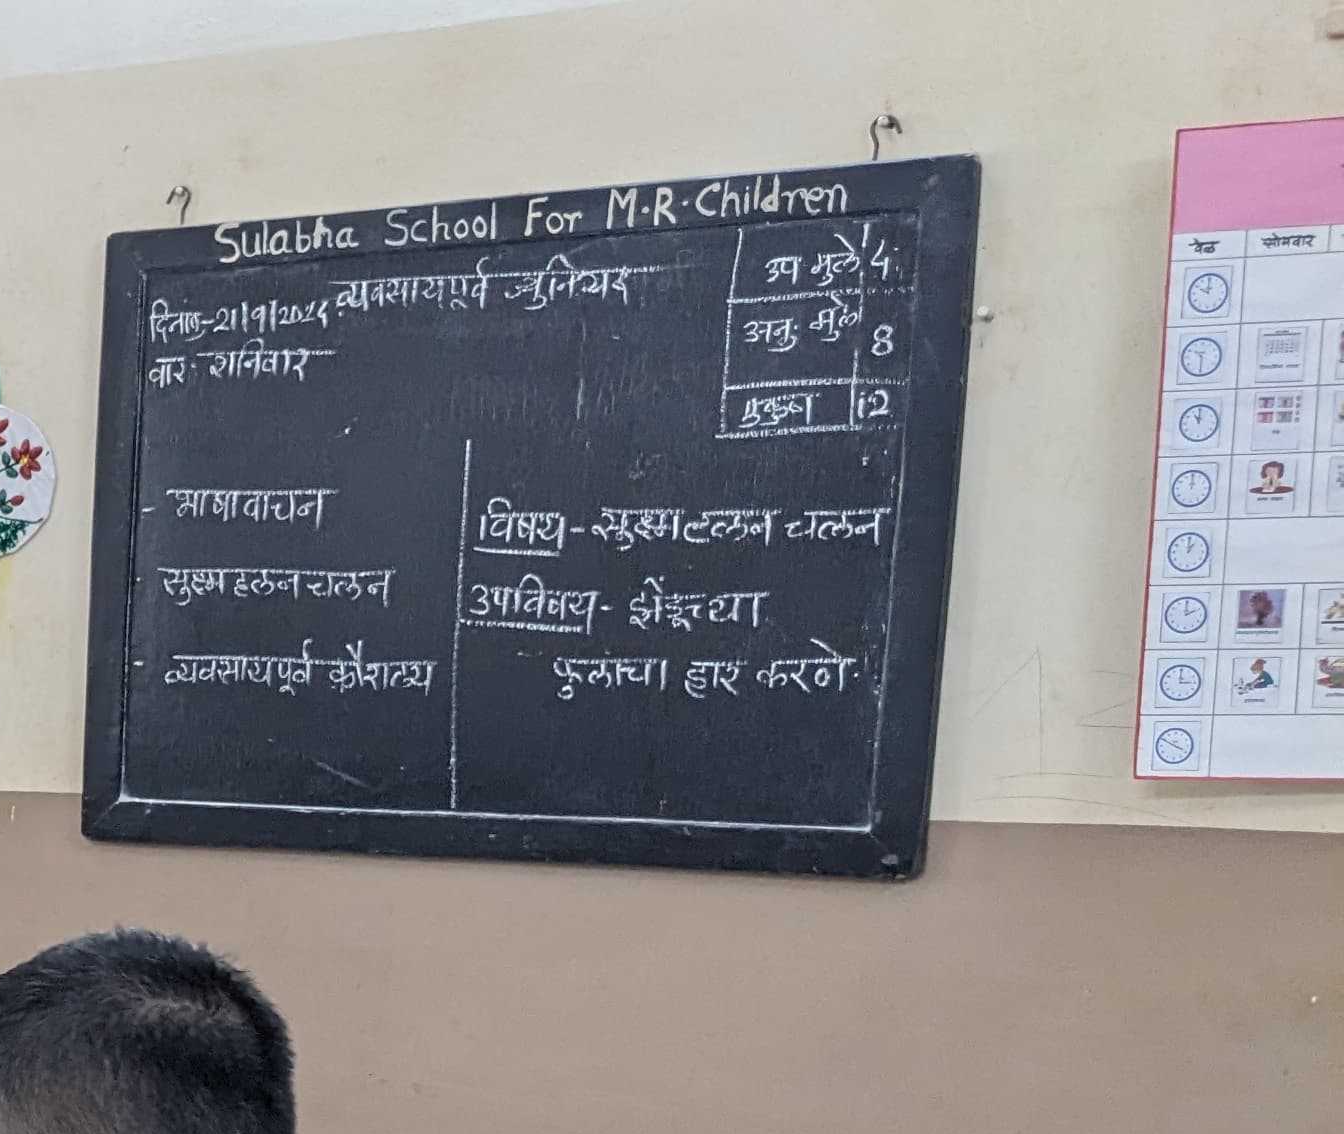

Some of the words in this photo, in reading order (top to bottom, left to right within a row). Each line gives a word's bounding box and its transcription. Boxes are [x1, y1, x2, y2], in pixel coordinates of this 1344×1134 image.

[214, 216, 360, 264] Sulabha
[384, 202, 497, 247] School
[523, 196, 583, 237] For
[1260, 232, 1317, 249] सोमवार
[870, 239, 891, 281] 4
[196, 337, 338, 382] शनिवार
[870, 324, 894, 357] 8
[857, 389, 892, 419] 12
[684, 658, 748, 699] हार
